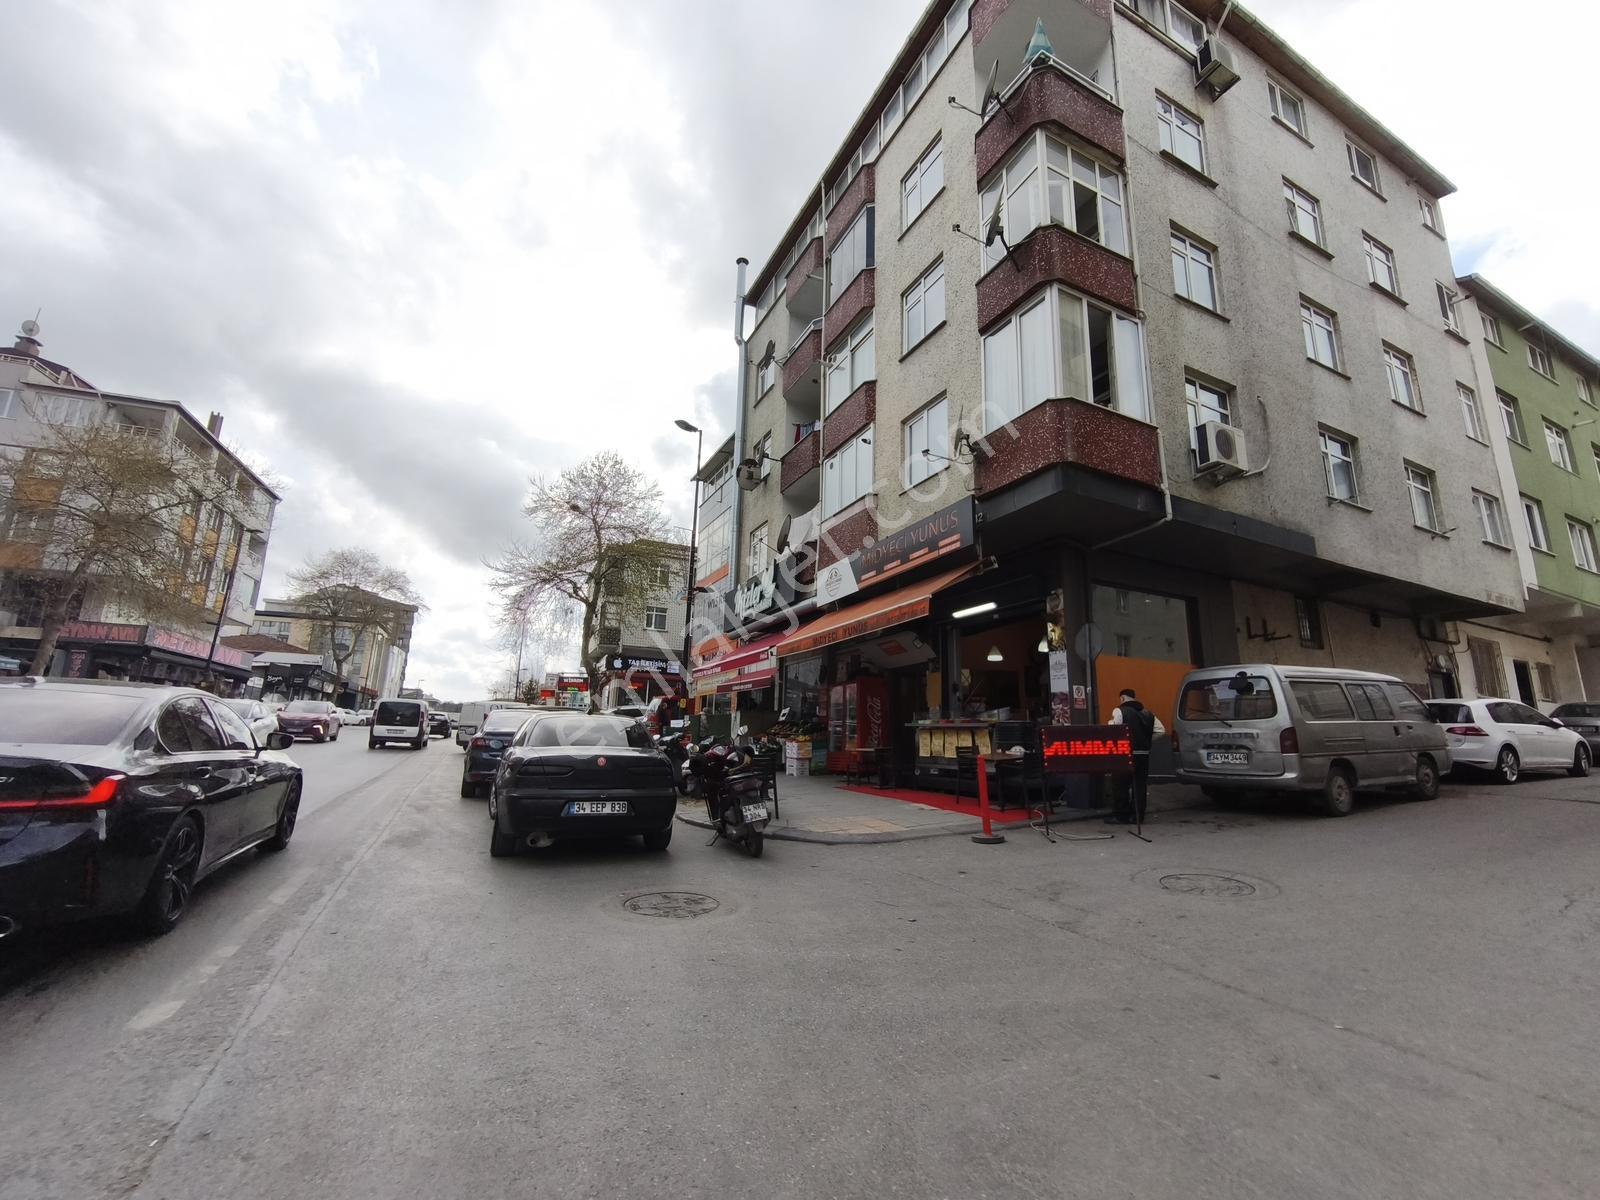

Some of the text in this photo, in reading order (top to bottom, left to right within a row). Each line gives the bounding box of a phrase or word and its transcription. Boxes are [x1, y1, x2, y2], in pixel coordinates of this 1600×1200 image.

[910, 510, 958, 545] YUNUS
[575, 802, 586, 813] 34
[590, 802, 607, 813] EEP
